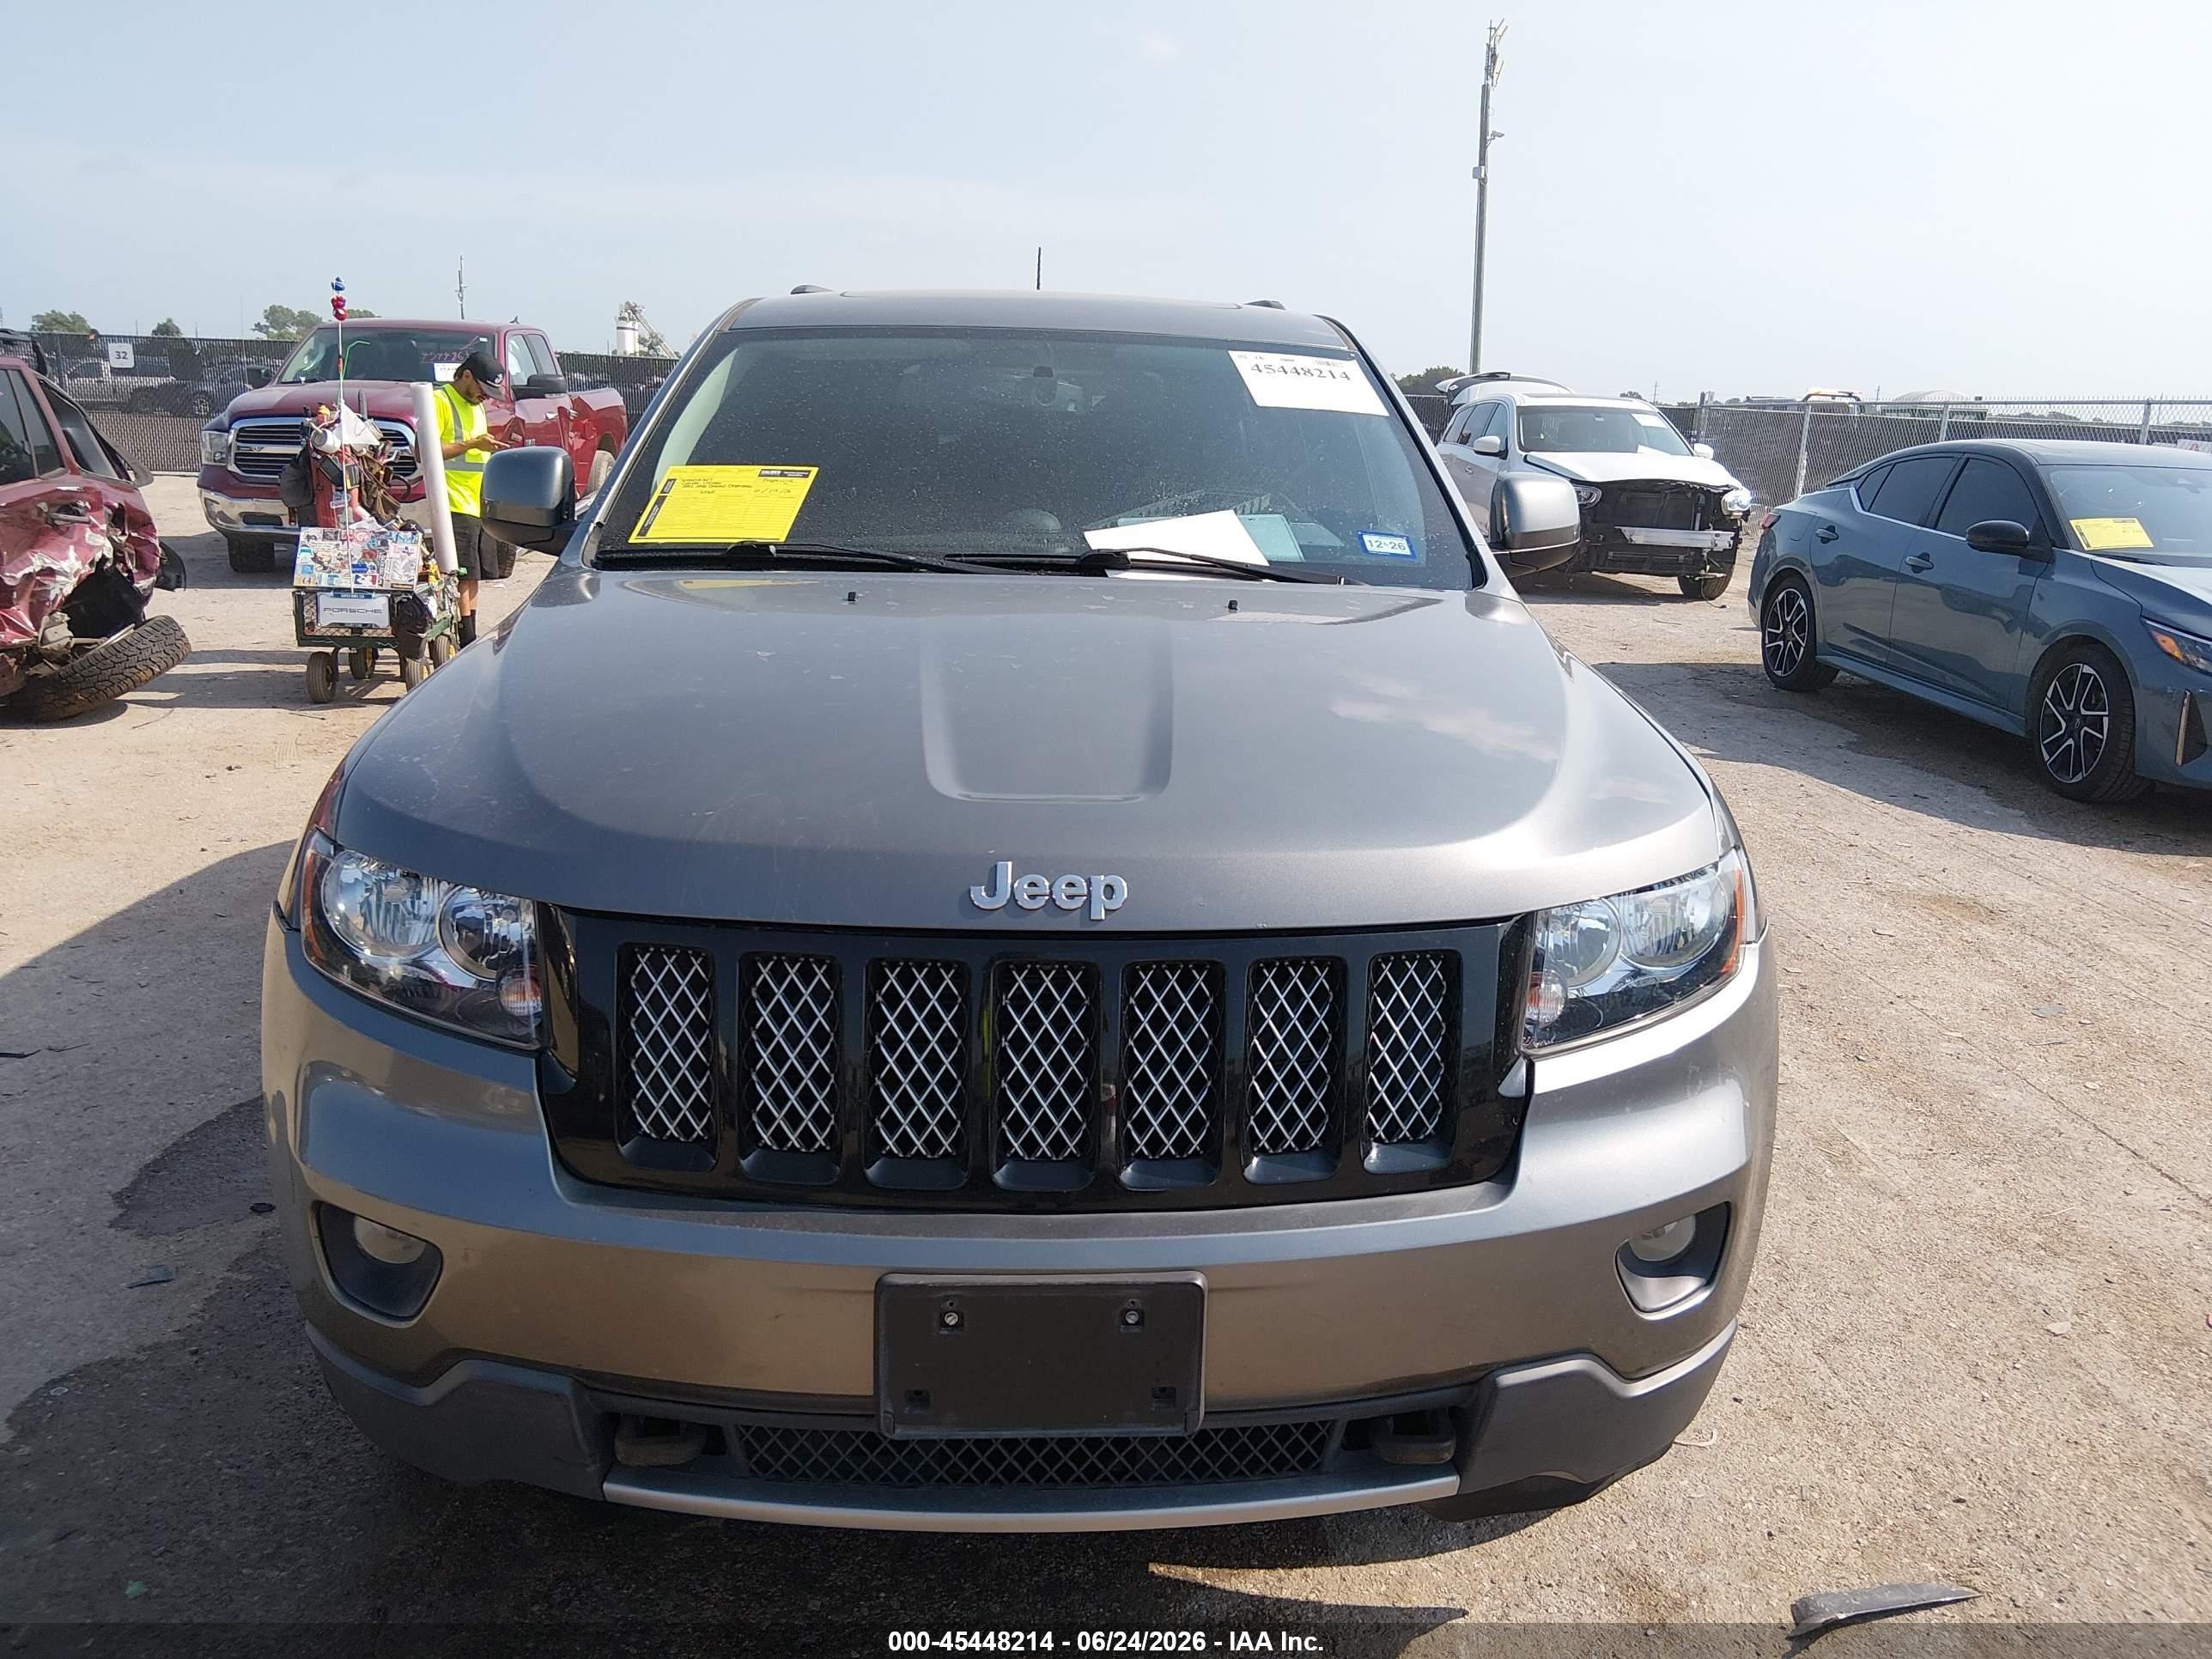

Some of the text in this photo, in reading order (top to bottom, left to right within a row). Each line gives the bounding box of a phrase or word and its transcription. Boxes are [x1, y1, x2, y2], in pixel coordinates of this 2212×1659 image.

[114, 350, 129, 360] 32
[1250, 363, 1351, 381] 45448214
[969, 860, 1128, 921] Jeep
